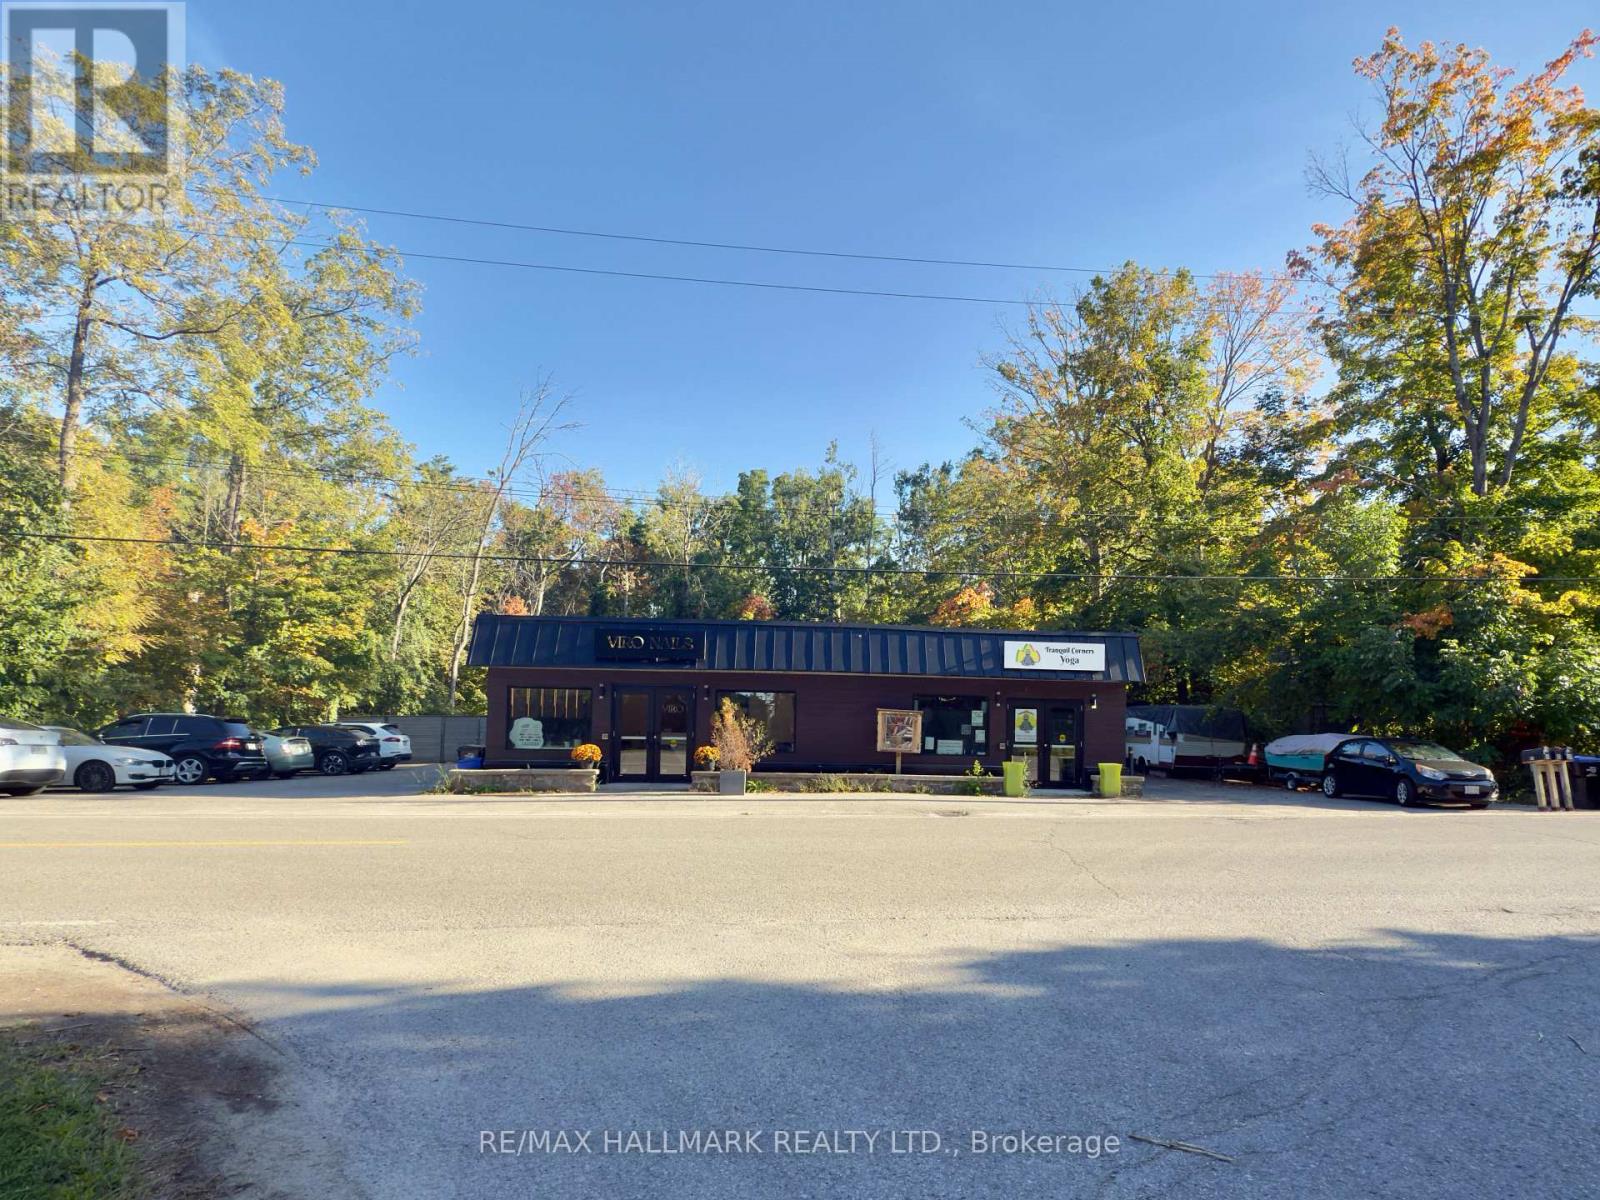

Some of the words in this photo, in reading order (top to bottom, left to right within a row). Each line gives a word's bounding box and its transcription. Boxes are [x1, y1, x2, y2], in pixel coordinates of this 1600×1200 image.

[607, 635, 645, 649] VIRO
[1045, 646, 1070, 654] Tranquil
[1071, 647, 1095, 655] Corners
[1060, 655, 1080, 666] Yoga
